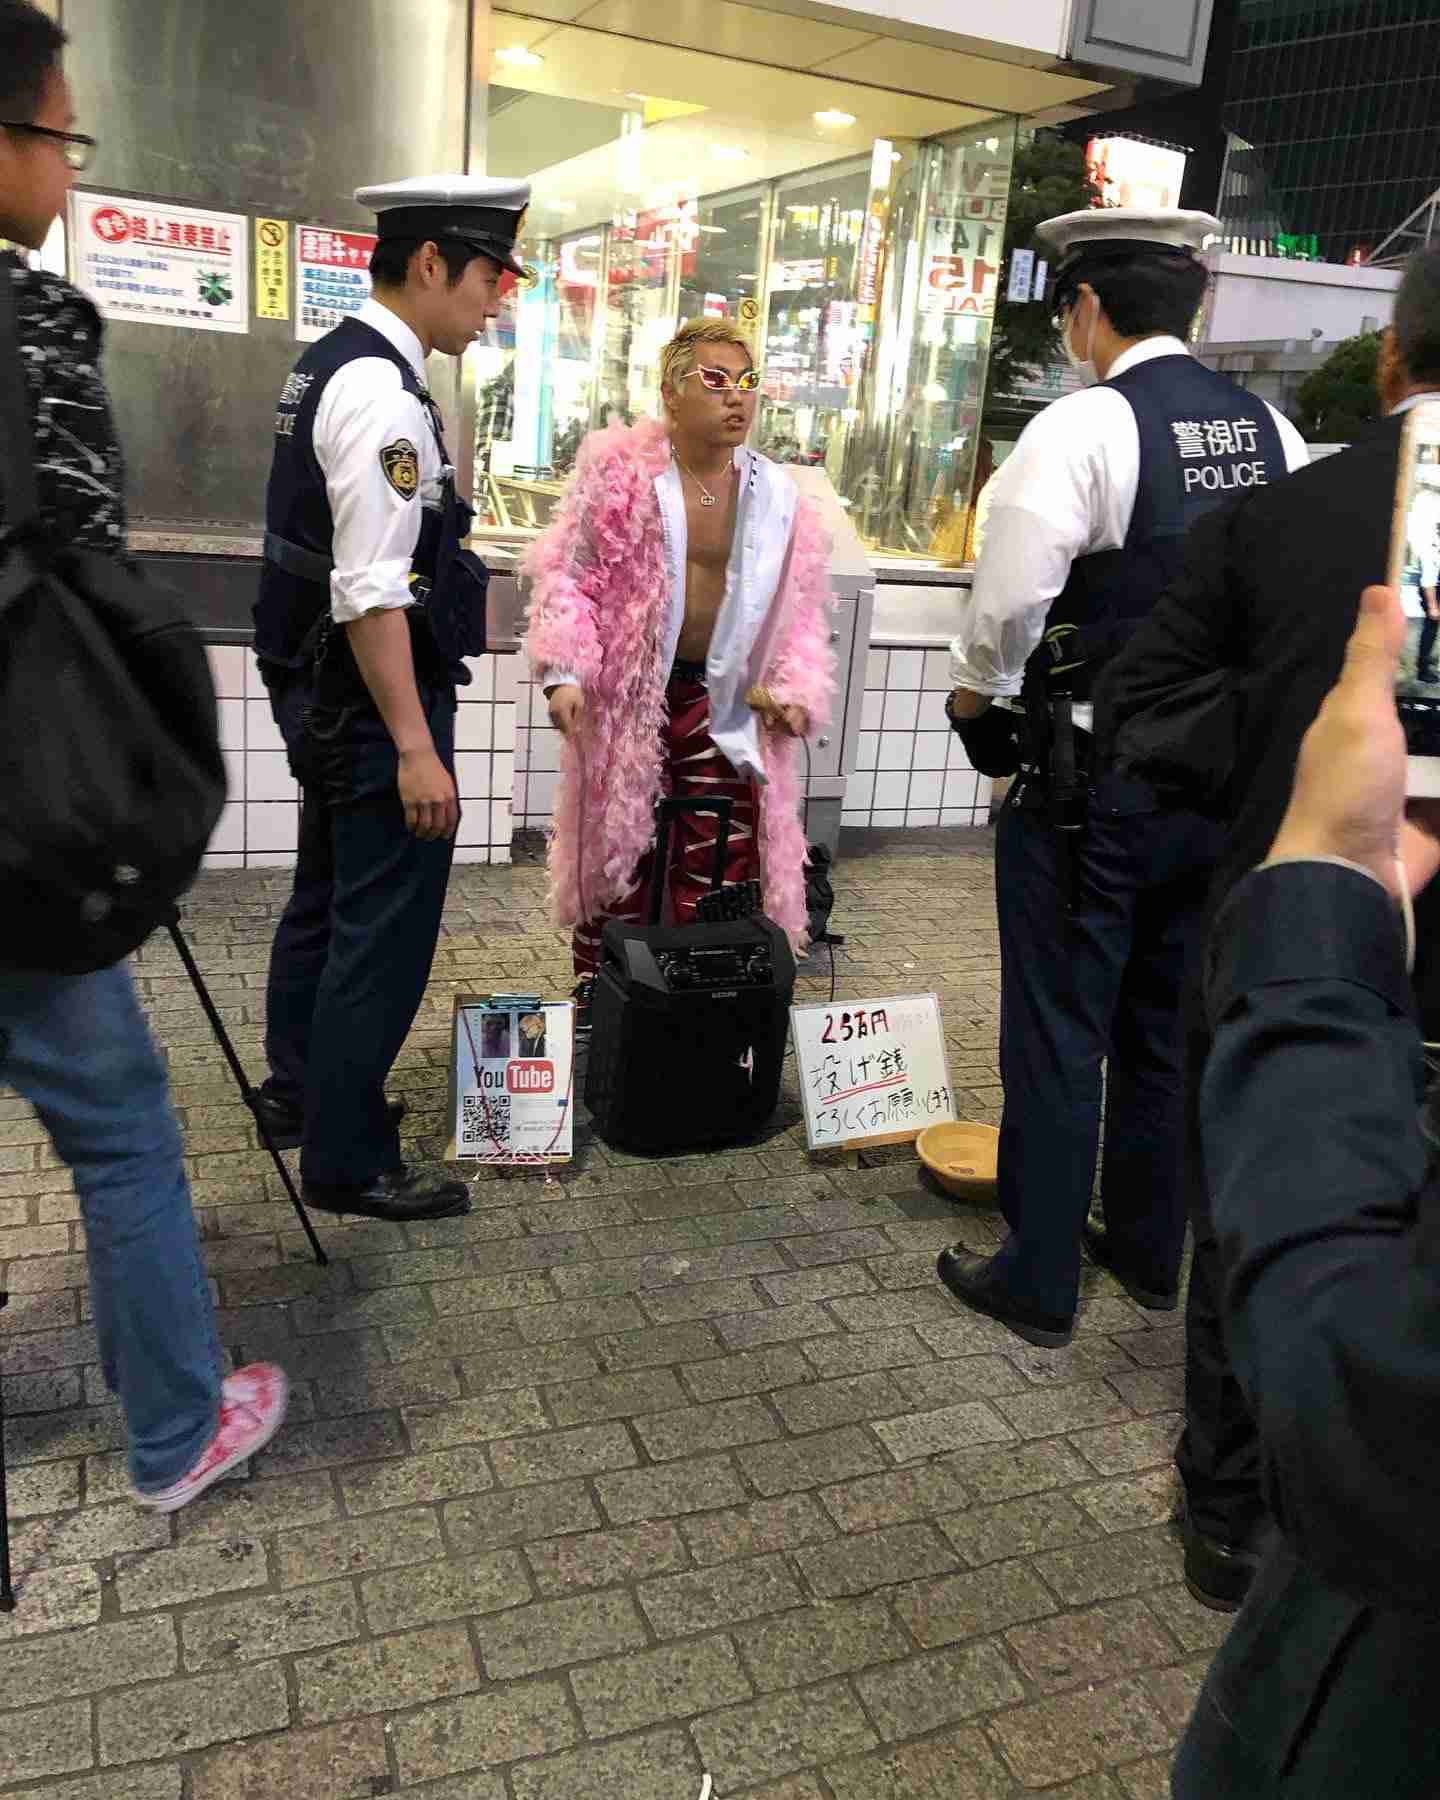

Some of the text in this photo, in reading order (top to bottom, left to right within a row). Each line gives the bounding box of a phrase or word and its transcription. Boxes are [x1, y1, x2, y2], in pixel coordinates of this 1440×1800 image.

[1171, 418, 1258, 458] 警視庁
[1184, 462, 1268, 492] POLICE
